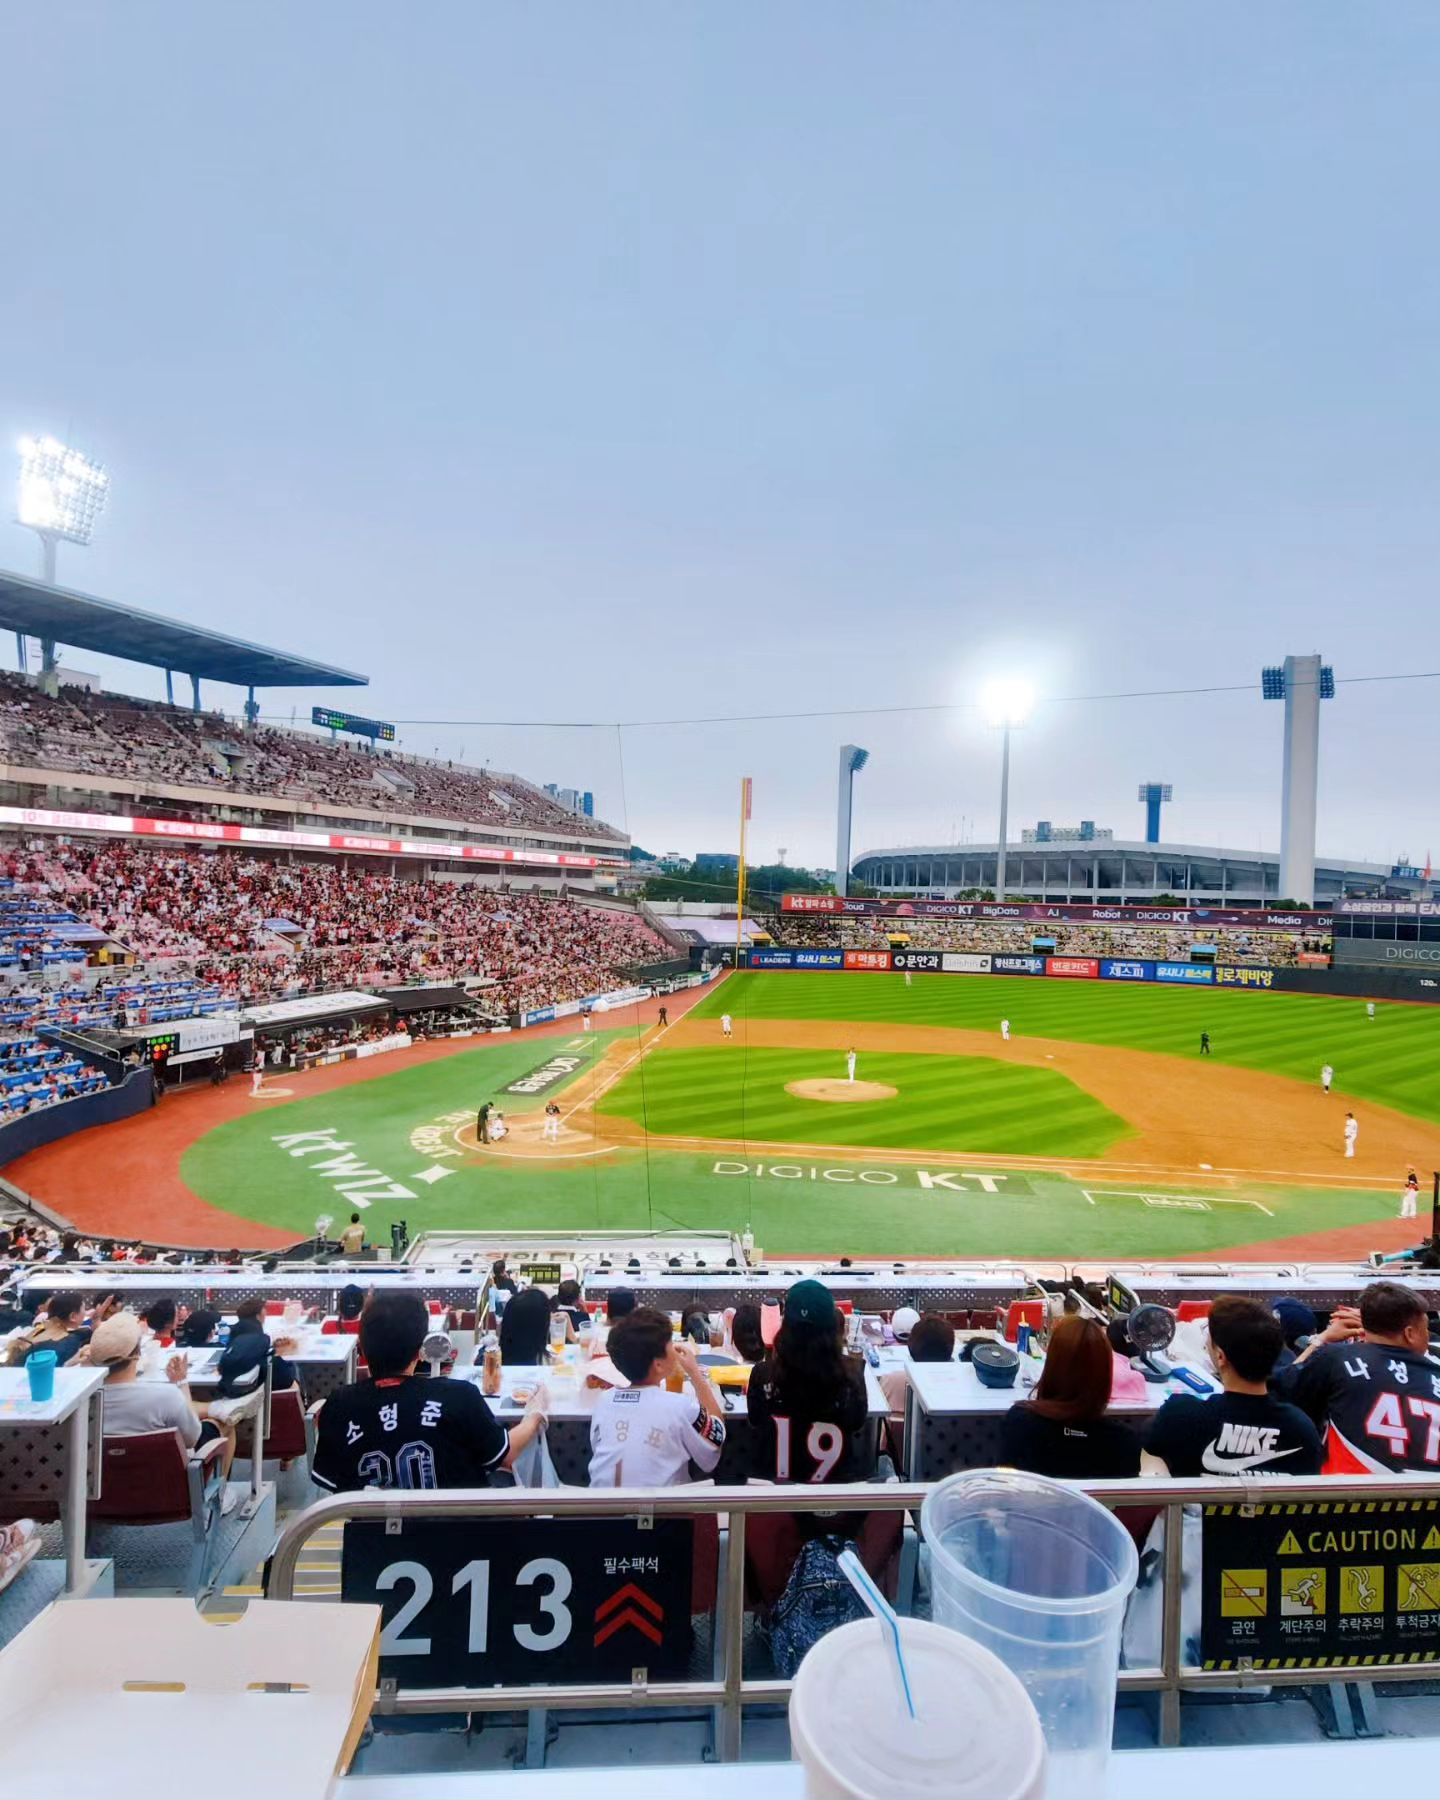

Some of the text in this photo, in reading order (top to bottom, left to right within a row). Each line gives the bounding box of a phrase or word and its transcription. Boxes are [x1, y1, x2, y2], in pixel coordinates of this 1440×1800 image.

[926, 905, 974, 915] DIGICO KT
[983, 906, 1019, 917] BigData
[1093, 909, 1121, 919] Robot
[1136, 911, 1190, 921] DIGICO KT
[1267, 915, 1302, 925] Media
[906, 955, 939, 968] 문안과
[1223, 967, 1274, 987] 로제비앙
[712, 1160, 1008, 1193] DIGICO KT
[346, 1401, 442, 1446] 소형준
[1366, 1391, 1440, 1463] 47
[1217, 1423, 1281, 1456] NIKE
[770, 1415, 844, 1483] 19
[1308, 1529, 1416, 1553] CAUTION
[603, 1556, 659, 1575] 필수팩석
[375, 1557, 573, 1657] 213
[1231, 1620, 1256, 1636] 금연
[1280, 1618, 1326, 1634] 계단주의
[1338, 1616, 1384, 1632] 추락주의
[1395, 1613, 1440, 1630] 투척금지
